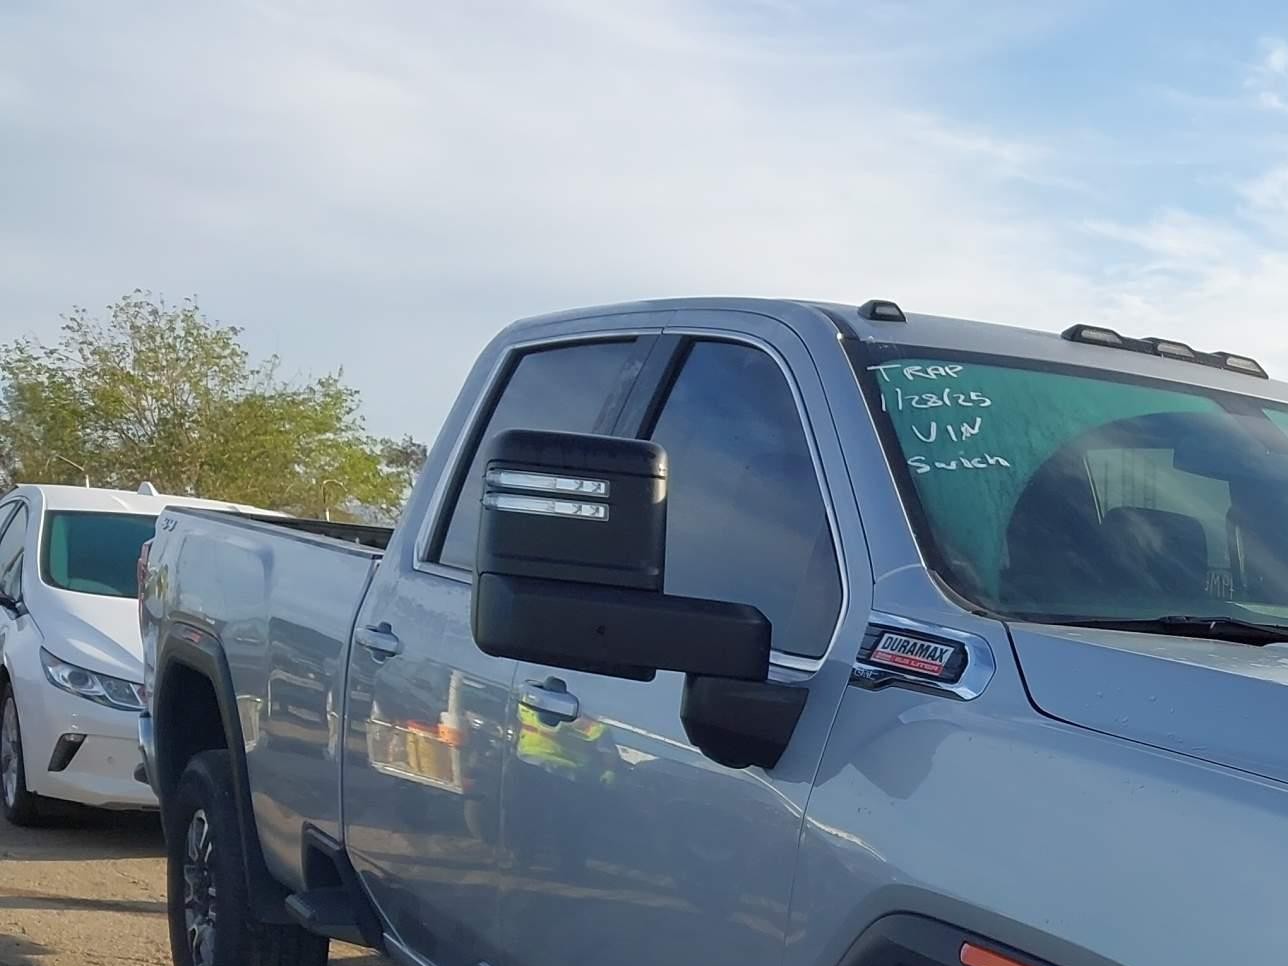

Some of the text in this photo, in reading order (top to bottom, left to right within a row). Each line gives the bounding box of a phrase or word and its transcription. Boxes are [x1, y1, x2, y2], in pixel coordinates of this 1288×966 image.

[866, 364, 964, 382] TRAP
[911, 417, 982, 442] VIN
[881, 636, 950, 663] DURAMAX
